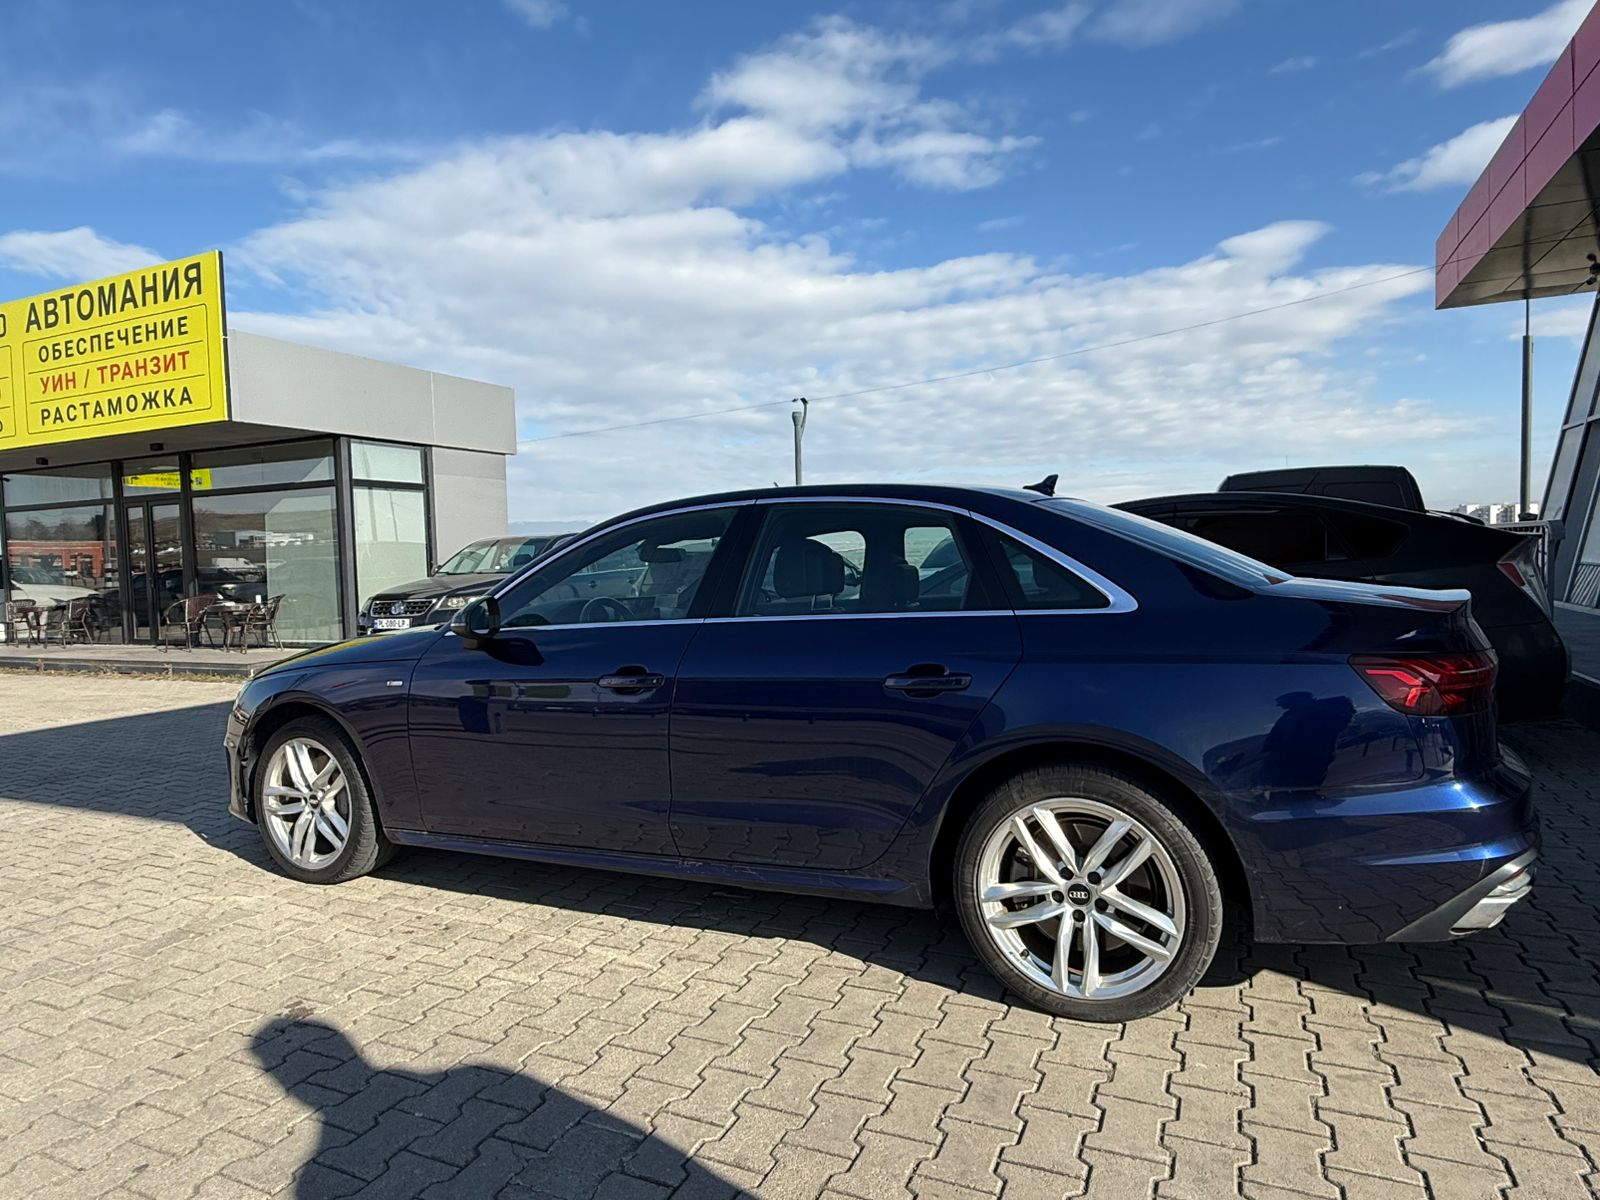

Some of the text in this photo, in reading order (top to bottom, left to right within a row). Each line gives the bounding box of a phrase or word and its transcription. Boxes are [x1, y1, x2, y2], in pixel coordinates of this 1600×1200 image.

[25, 261, 203, 334] АВТОМАНИЯ
[38, 315, 189, 363] ОБЕСПЕЧЕНИЕ
[40, 371, 77, 394] УИН
[96, 350, 190, 384] ТРАНЗИТ
[40, 386, 193, 426] РАСТАМОЖКА
